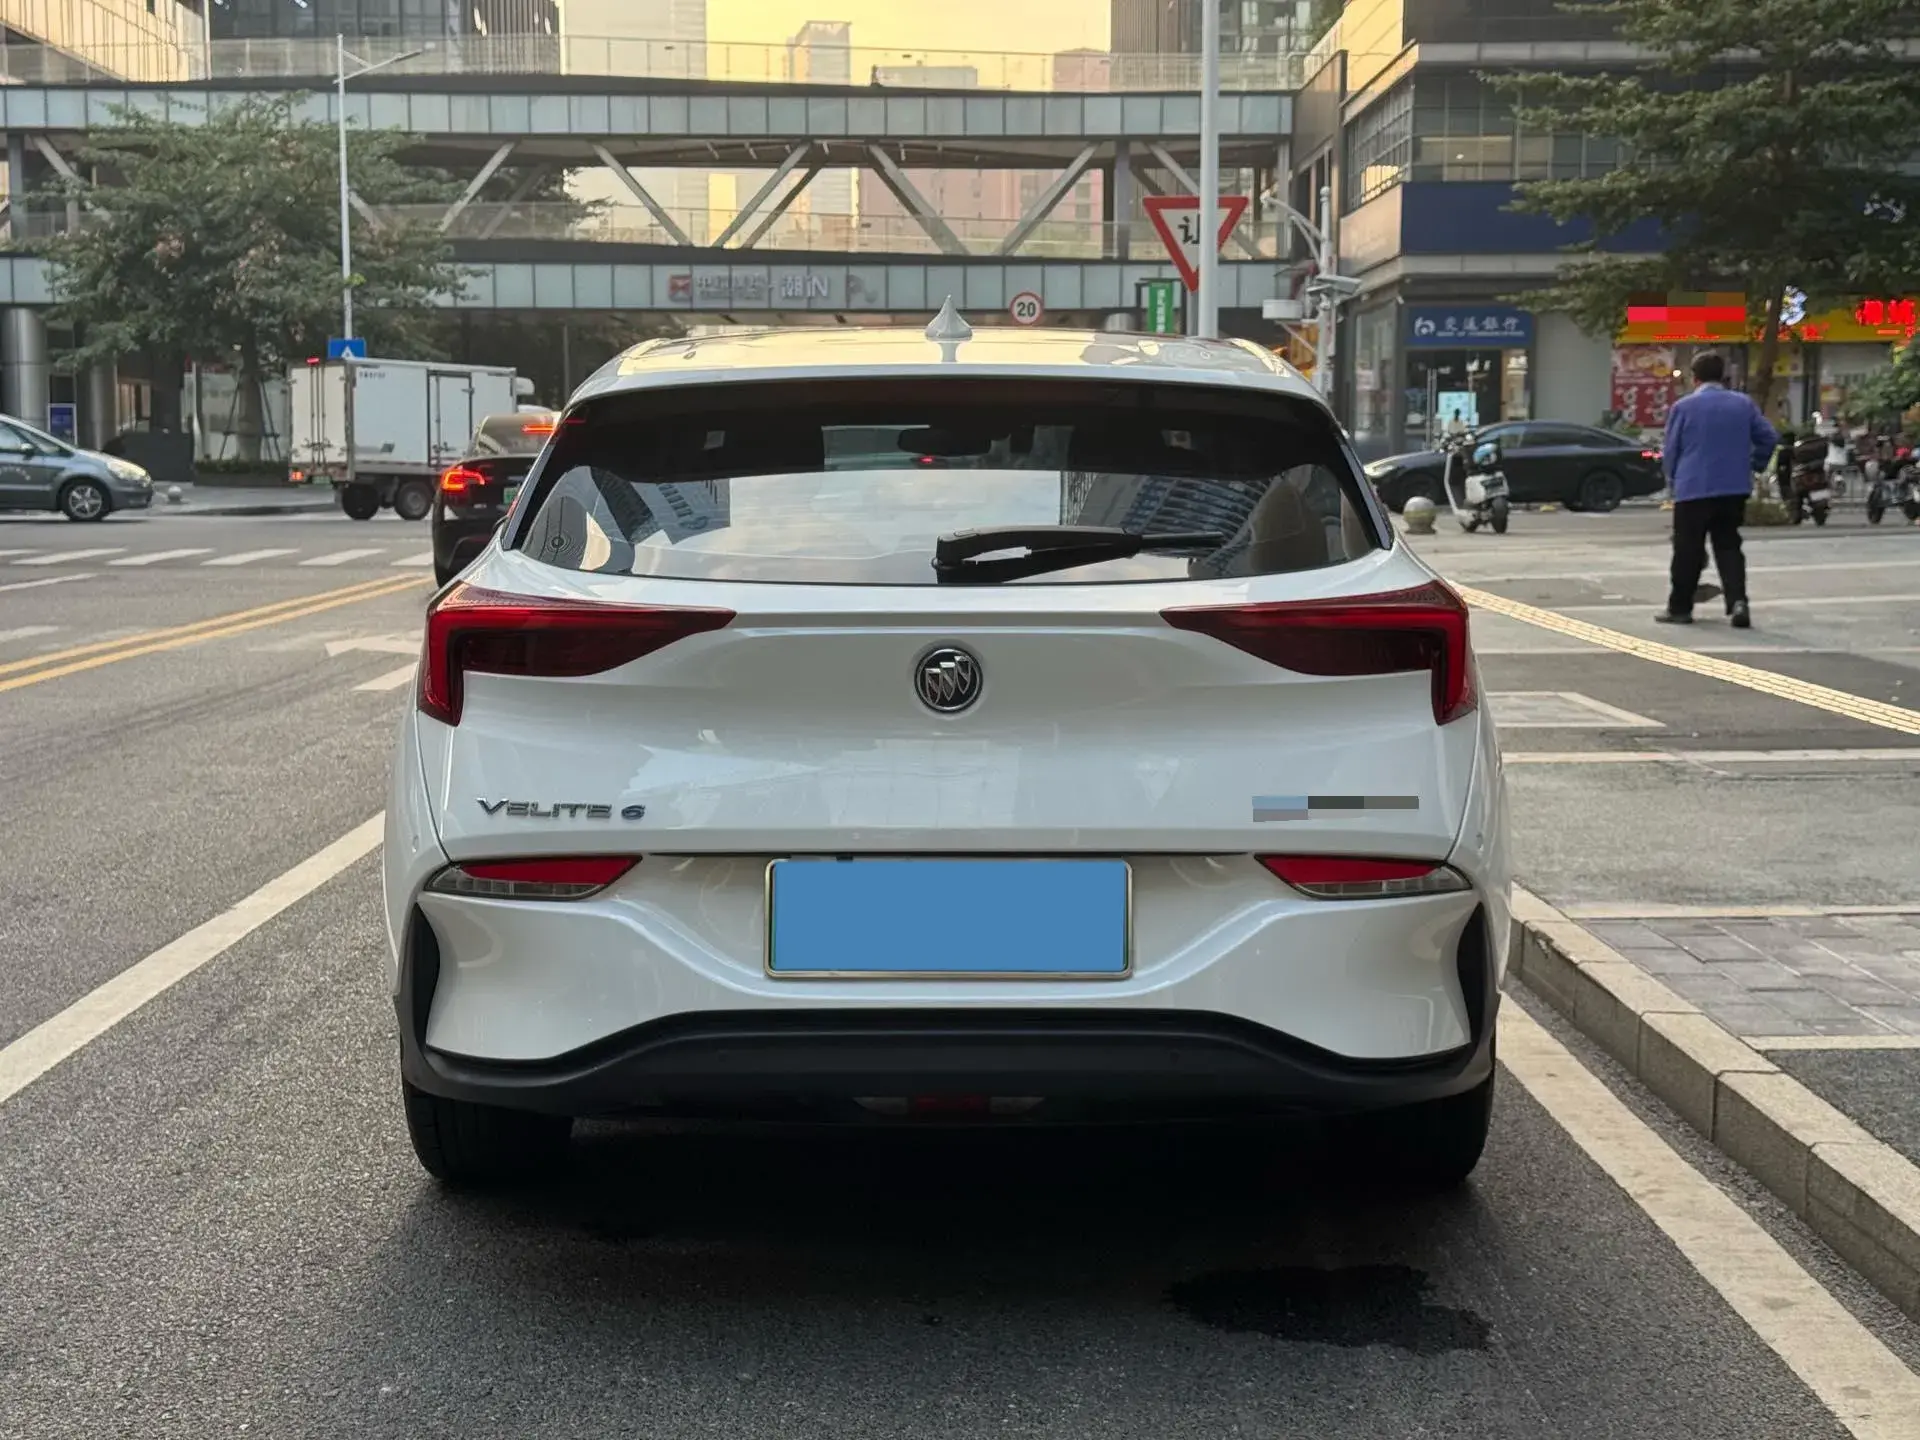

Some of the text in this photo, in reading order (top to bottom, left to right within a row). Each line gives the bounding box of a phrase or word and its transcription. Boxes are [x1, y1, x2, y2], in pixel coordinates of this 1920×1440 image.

[1017, 301, 1036, 318] 20
[477, 797, 646, 821] VELITE 6
